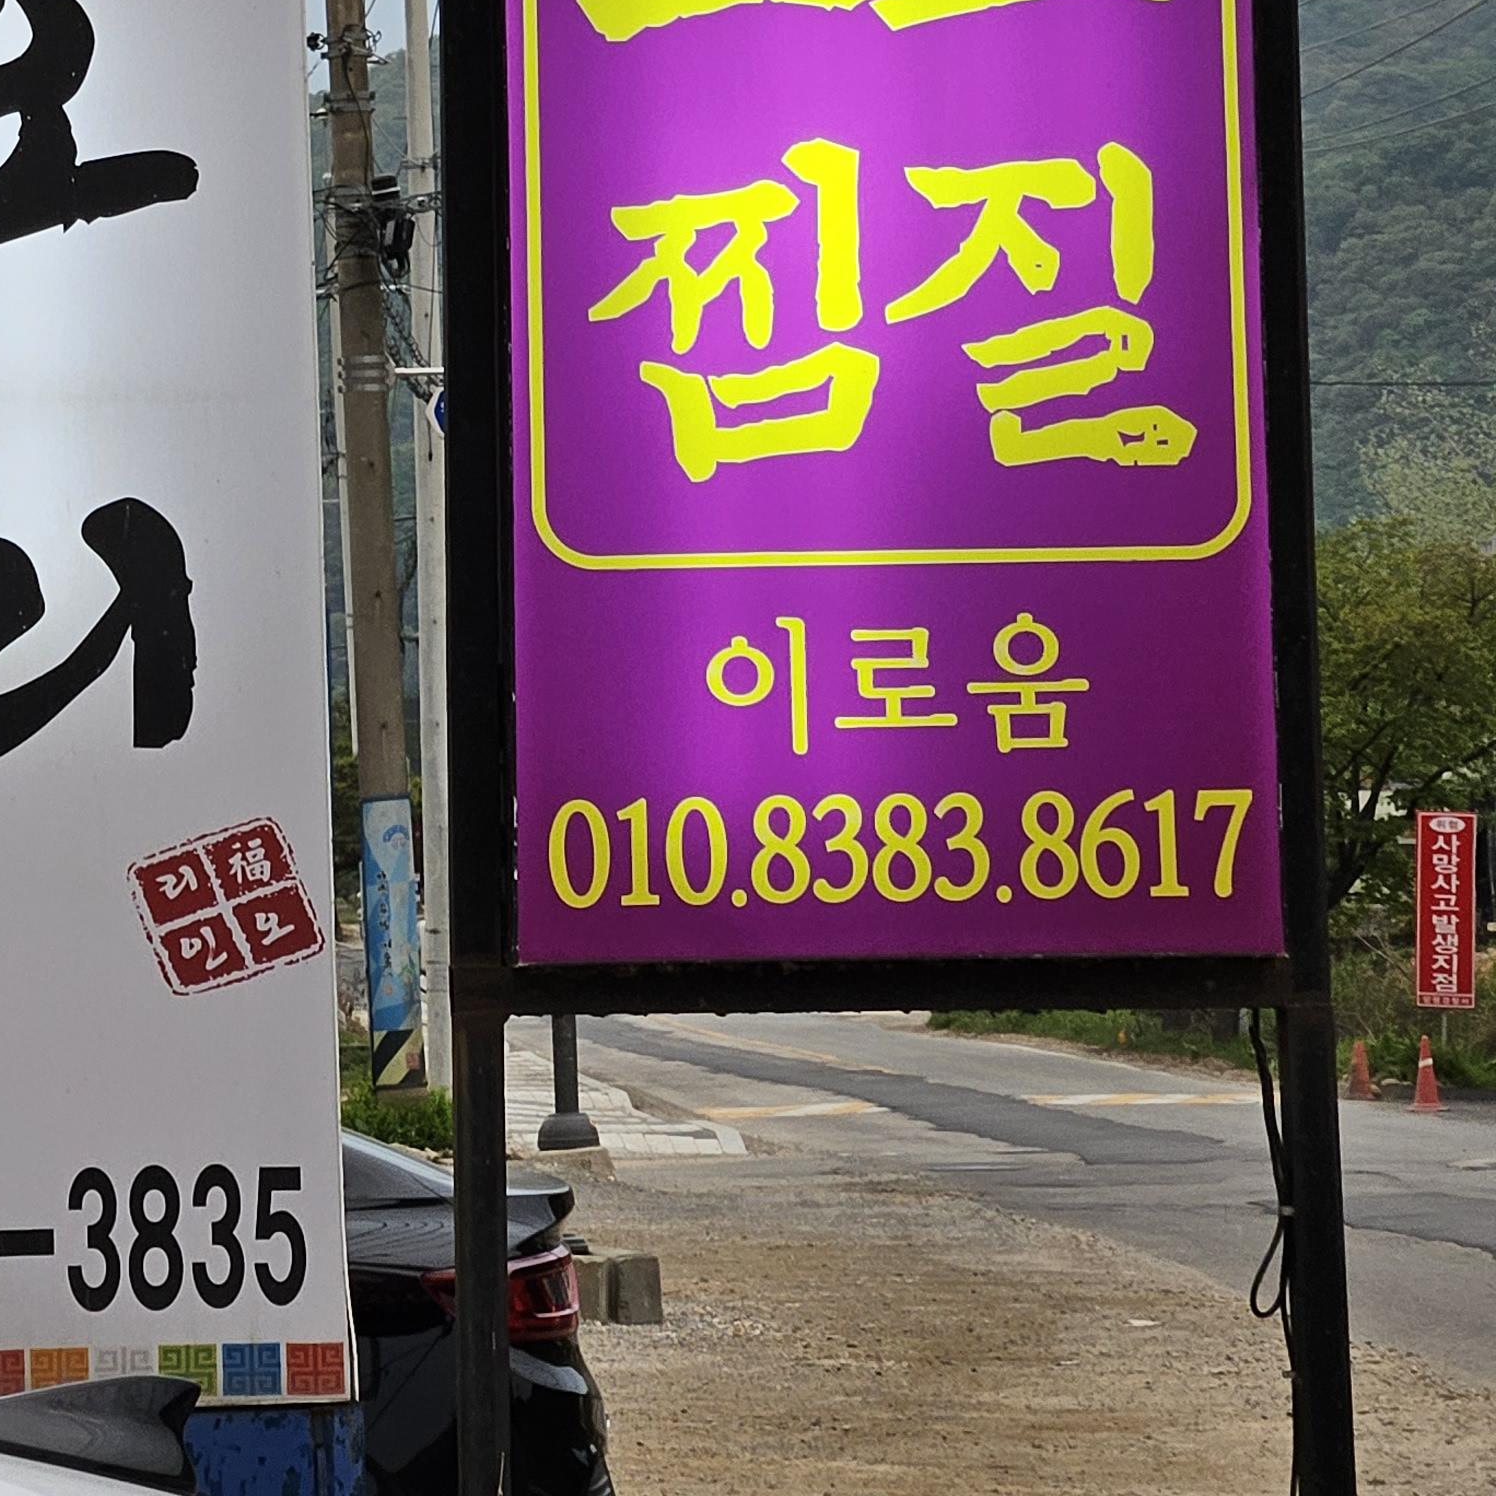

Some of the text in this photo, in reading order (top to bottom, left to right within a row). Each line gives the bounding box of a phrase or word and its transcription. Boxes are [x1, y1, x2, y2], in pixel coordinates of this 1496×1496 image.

[590, 140, 1195, 480] 찜질
[706, 613, 1089, 753] 이로움
[549, 789, 1252, 908] 010.8383.8617
